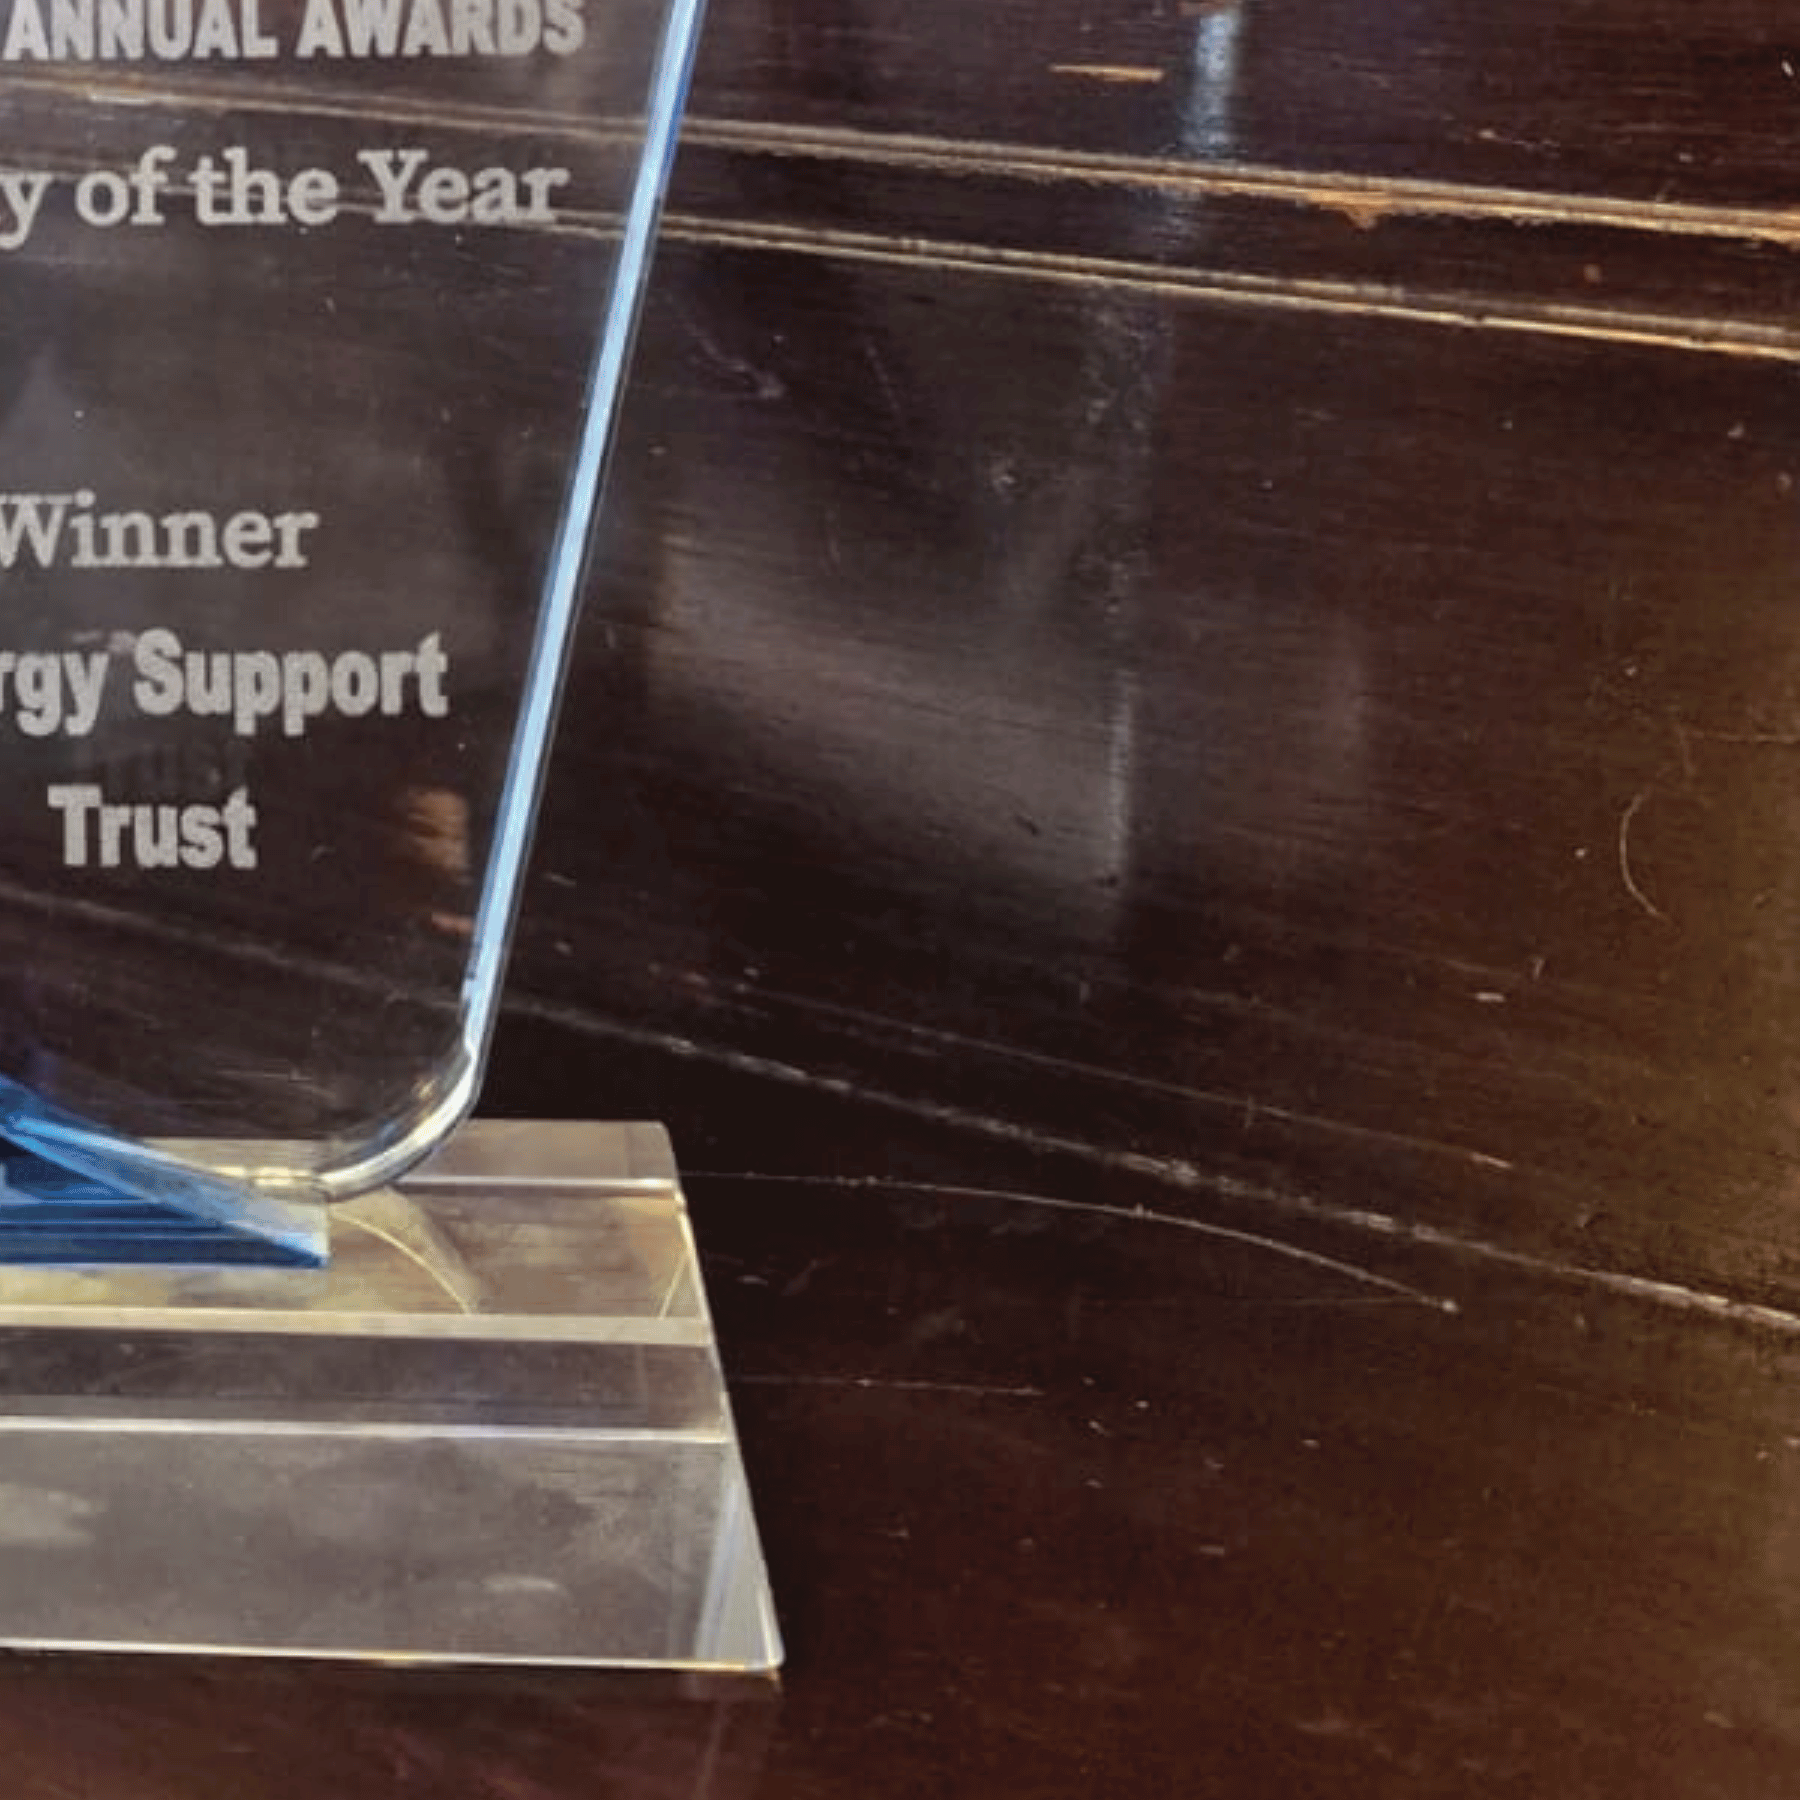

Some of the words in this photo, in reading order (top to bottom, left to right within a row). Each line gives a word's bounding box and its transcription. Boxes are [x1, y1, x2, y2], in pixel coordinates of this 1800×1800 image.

[76, 146, 176, 227] of
[189, 148, 338, 225] the
[359, 149, 569, 225] Year
[133, 628, 449, 736] Support
[47, 783, 257, 869] Trust
